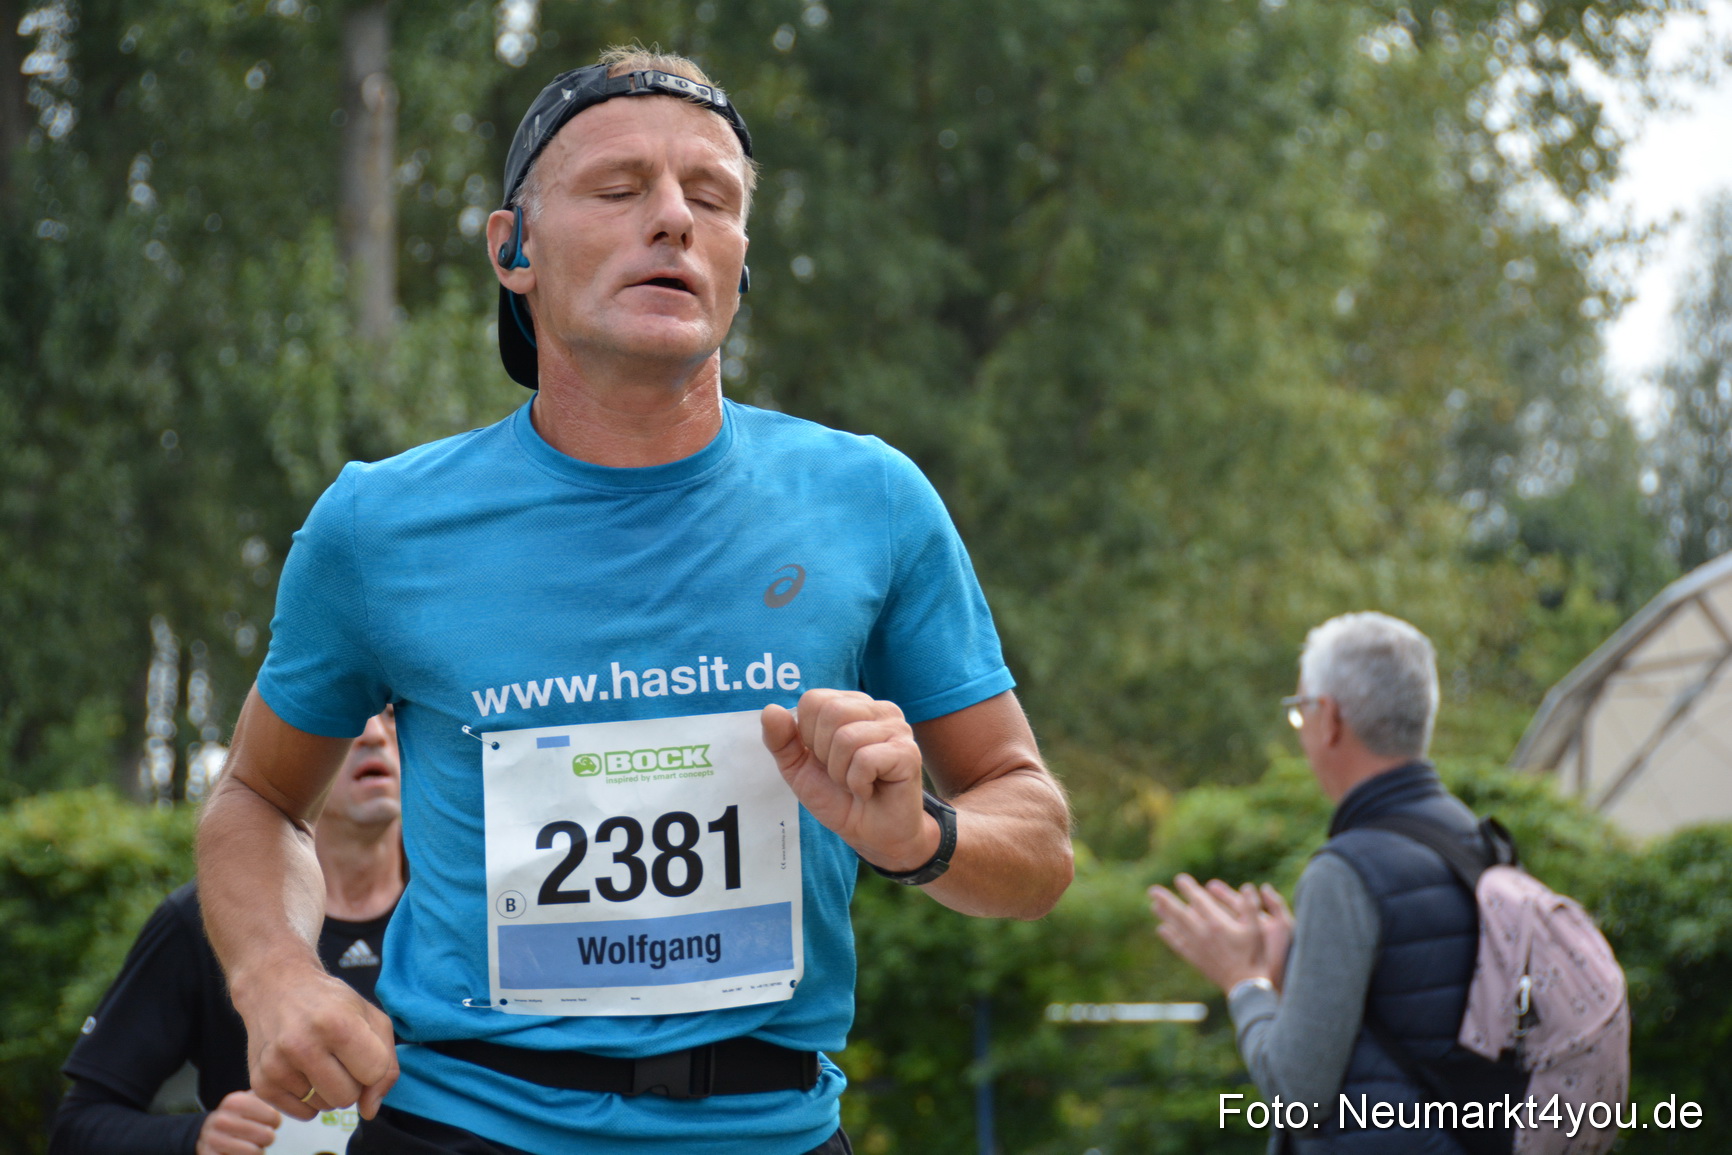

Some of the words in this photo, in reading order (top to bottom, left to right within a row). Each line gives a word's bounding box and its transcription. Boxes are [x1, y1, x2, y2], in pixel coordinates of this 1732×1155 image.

[472, 652, 801, 717] www.hasit.de
[604, 744, 713, 775] BOCK
[605, 775, 639, 785] inspired
[640, 774, 651, 783] by
[652, 773, 677, 782] smart
[679, 769, 715, 779] concepts
[535, 804, 742, 906] 2381
[505, 898, 517, 913] B
[577, 932, 722, 969] Wolfgang
